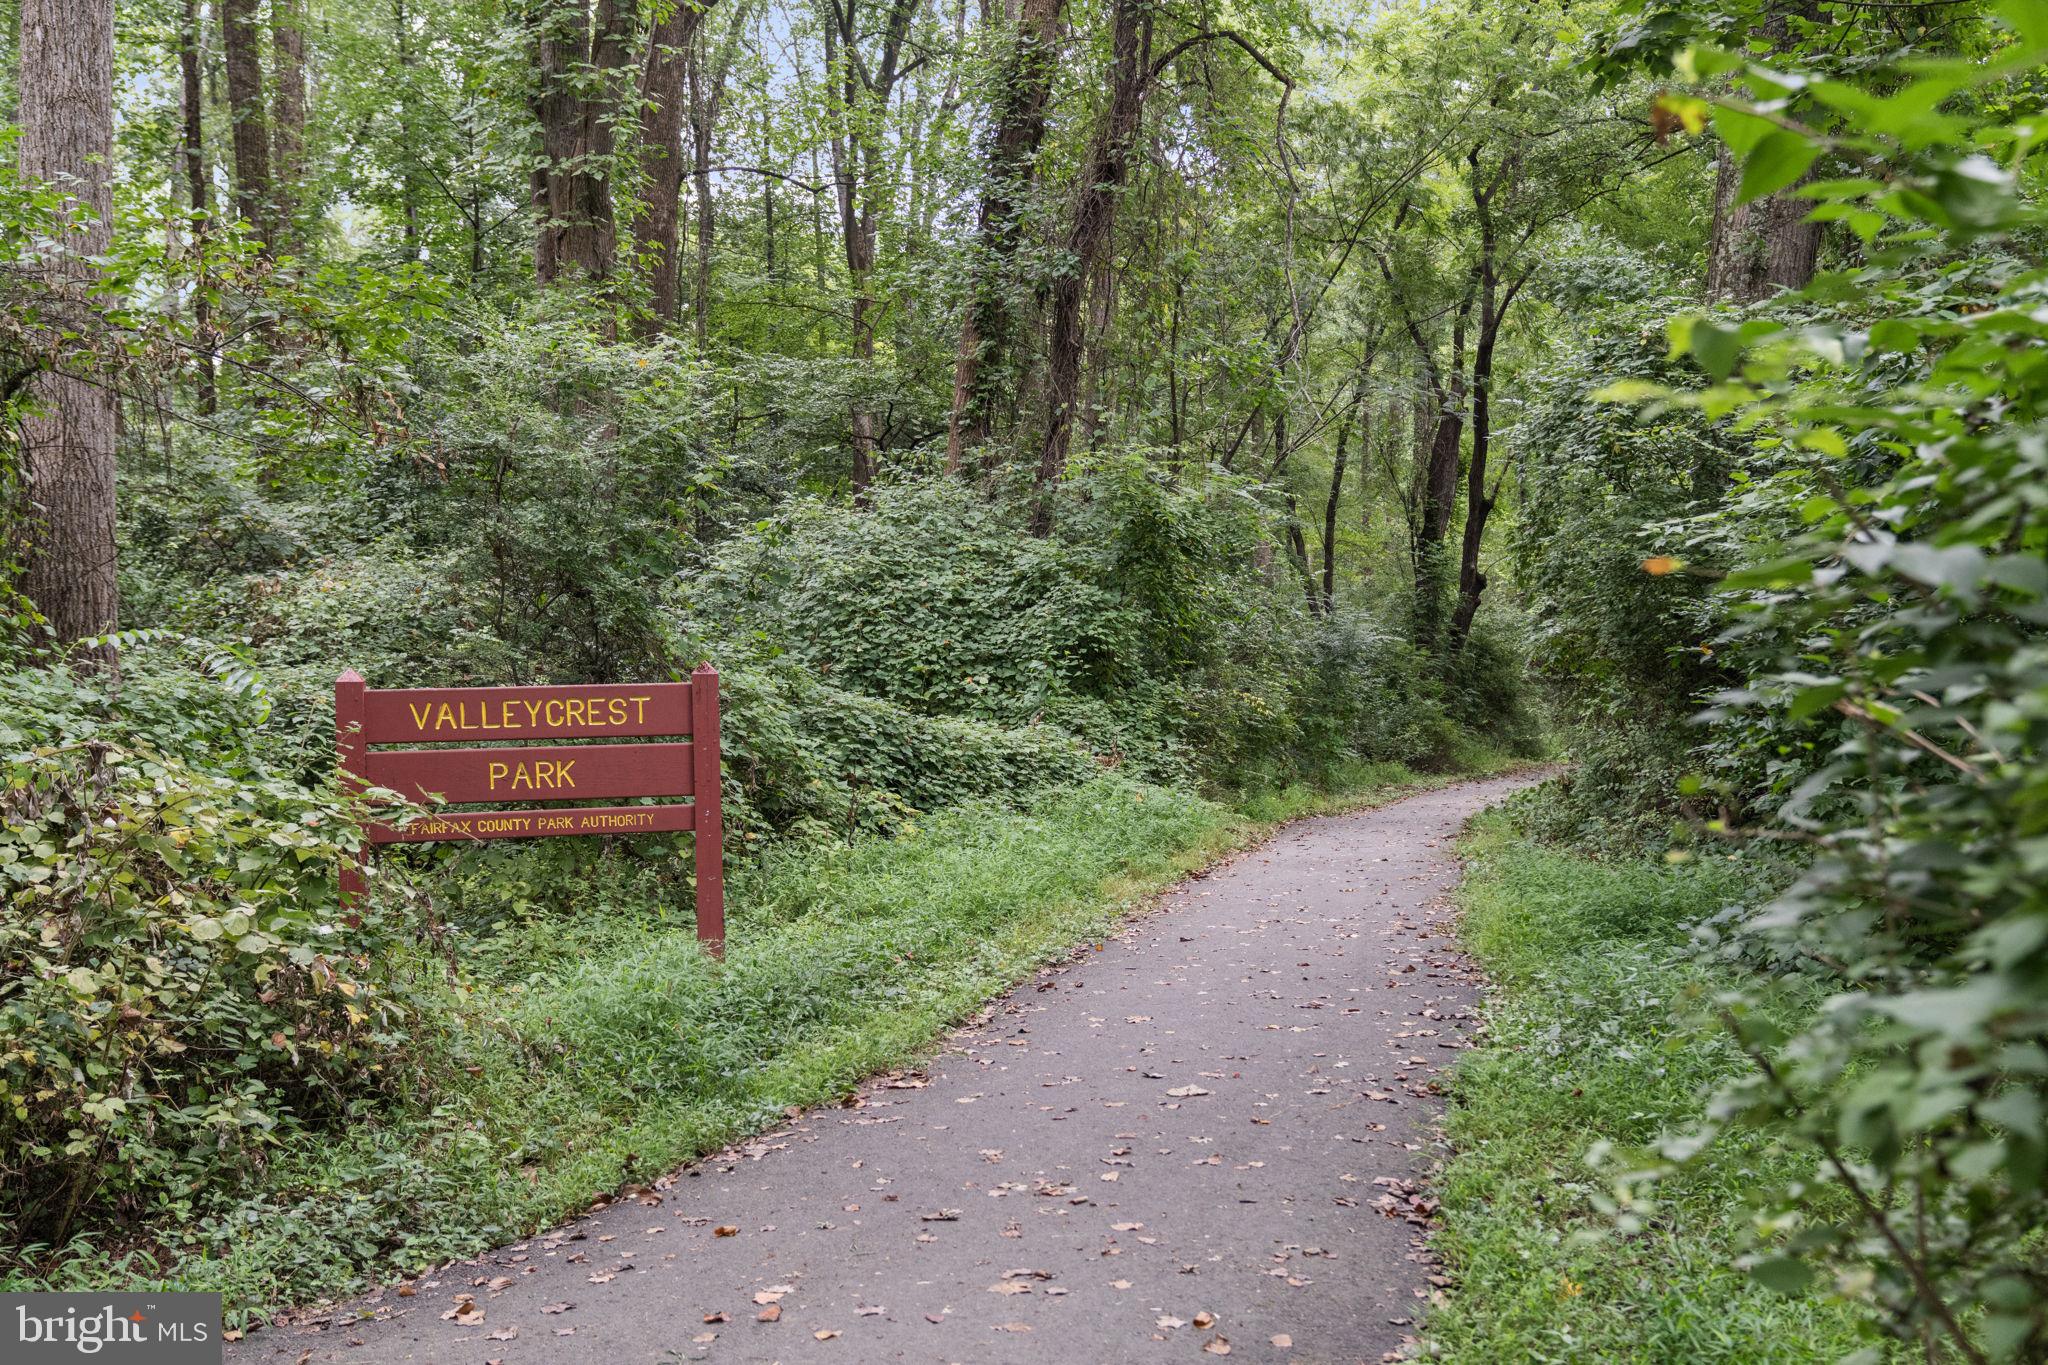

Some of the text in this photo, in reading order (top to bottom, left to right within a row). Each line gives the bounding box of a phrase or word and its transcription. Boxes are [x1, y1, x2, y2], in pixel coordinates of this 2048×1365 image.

[408, 696, 652, 731] VALLEYCREST
[488, 759, 576, 790] PARK
[411, 813, 655, 835] FAIRFAX COUNTY PARK AUTHORITY
